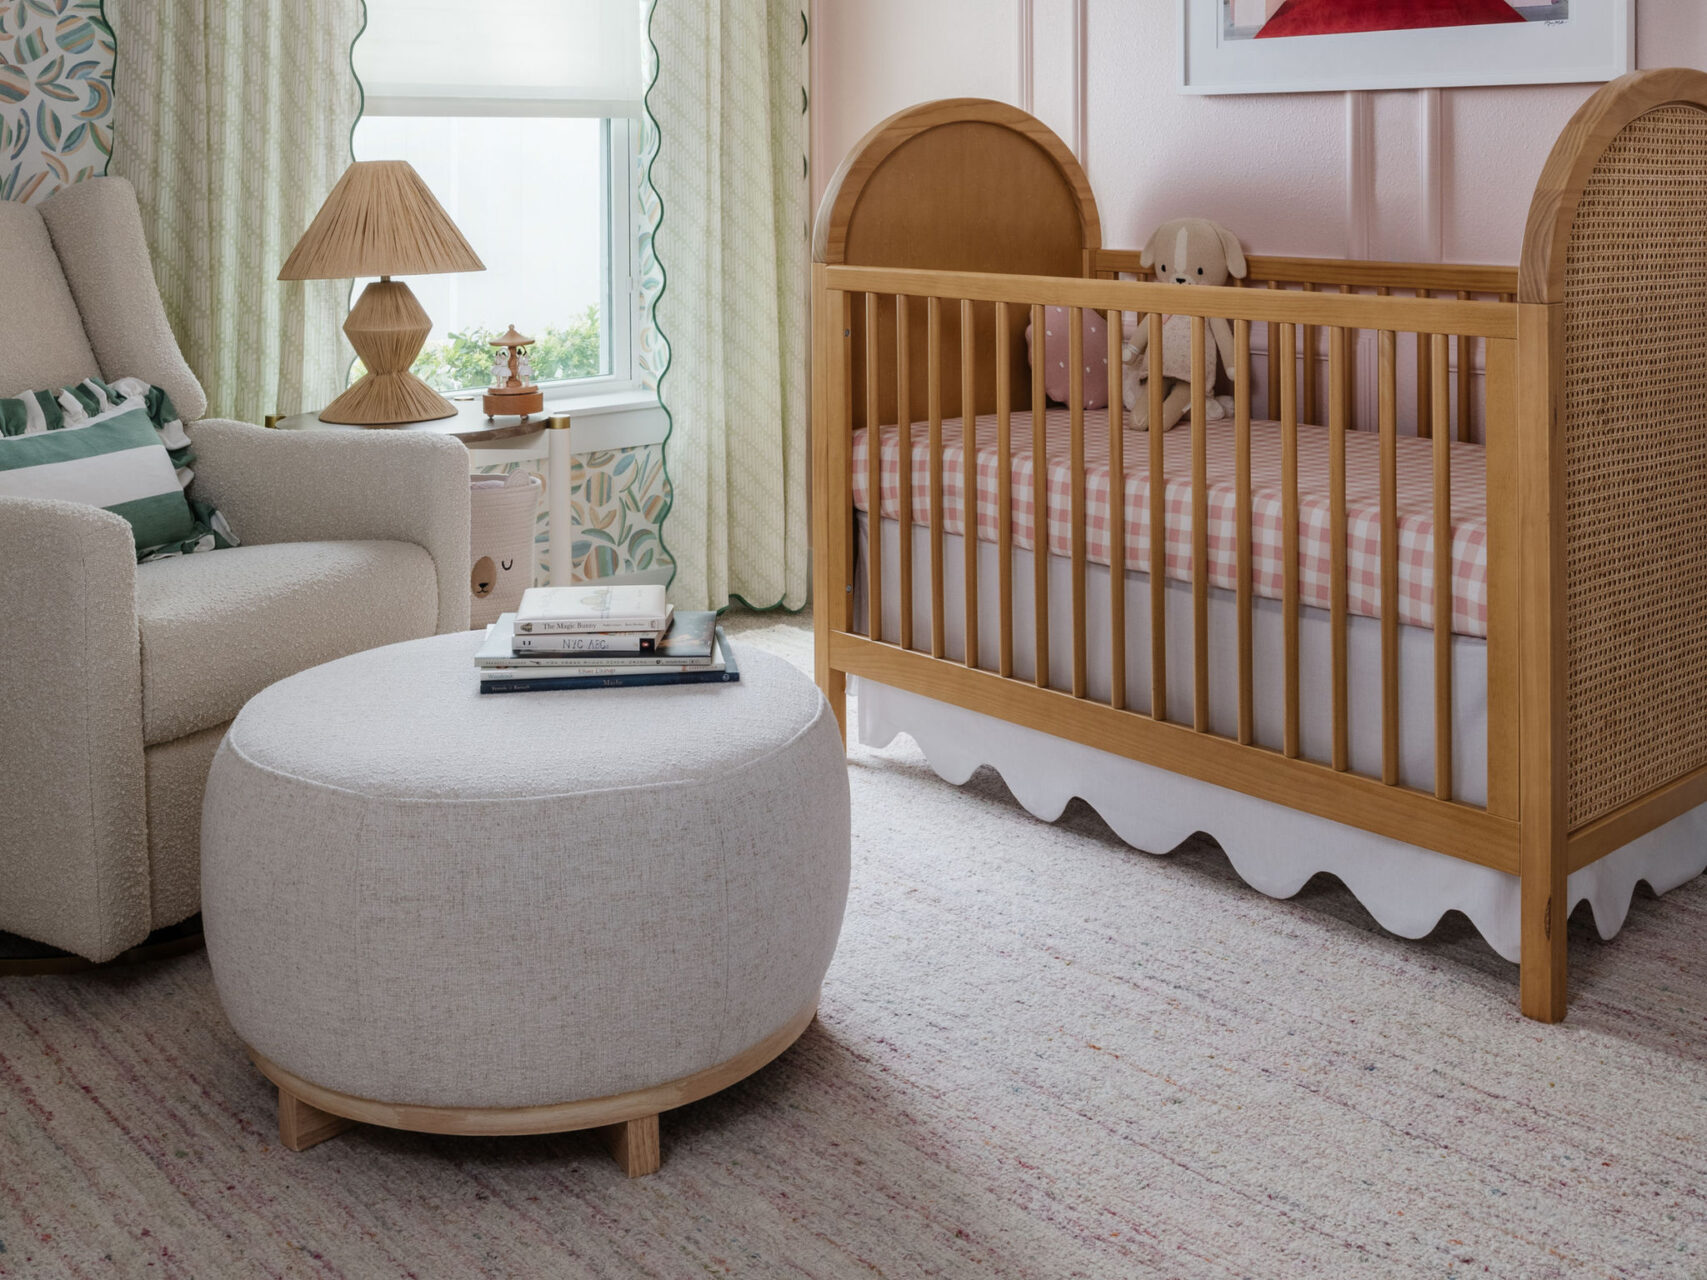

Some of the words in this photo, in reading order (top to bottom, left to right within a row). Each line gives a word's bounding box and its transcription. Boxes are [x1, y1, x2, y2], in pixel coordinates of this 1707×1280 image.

[556, 623, 574, 631] Magic
[577, 622, 597, 630] Bunny
[562, 639, 584, 649] NYC
